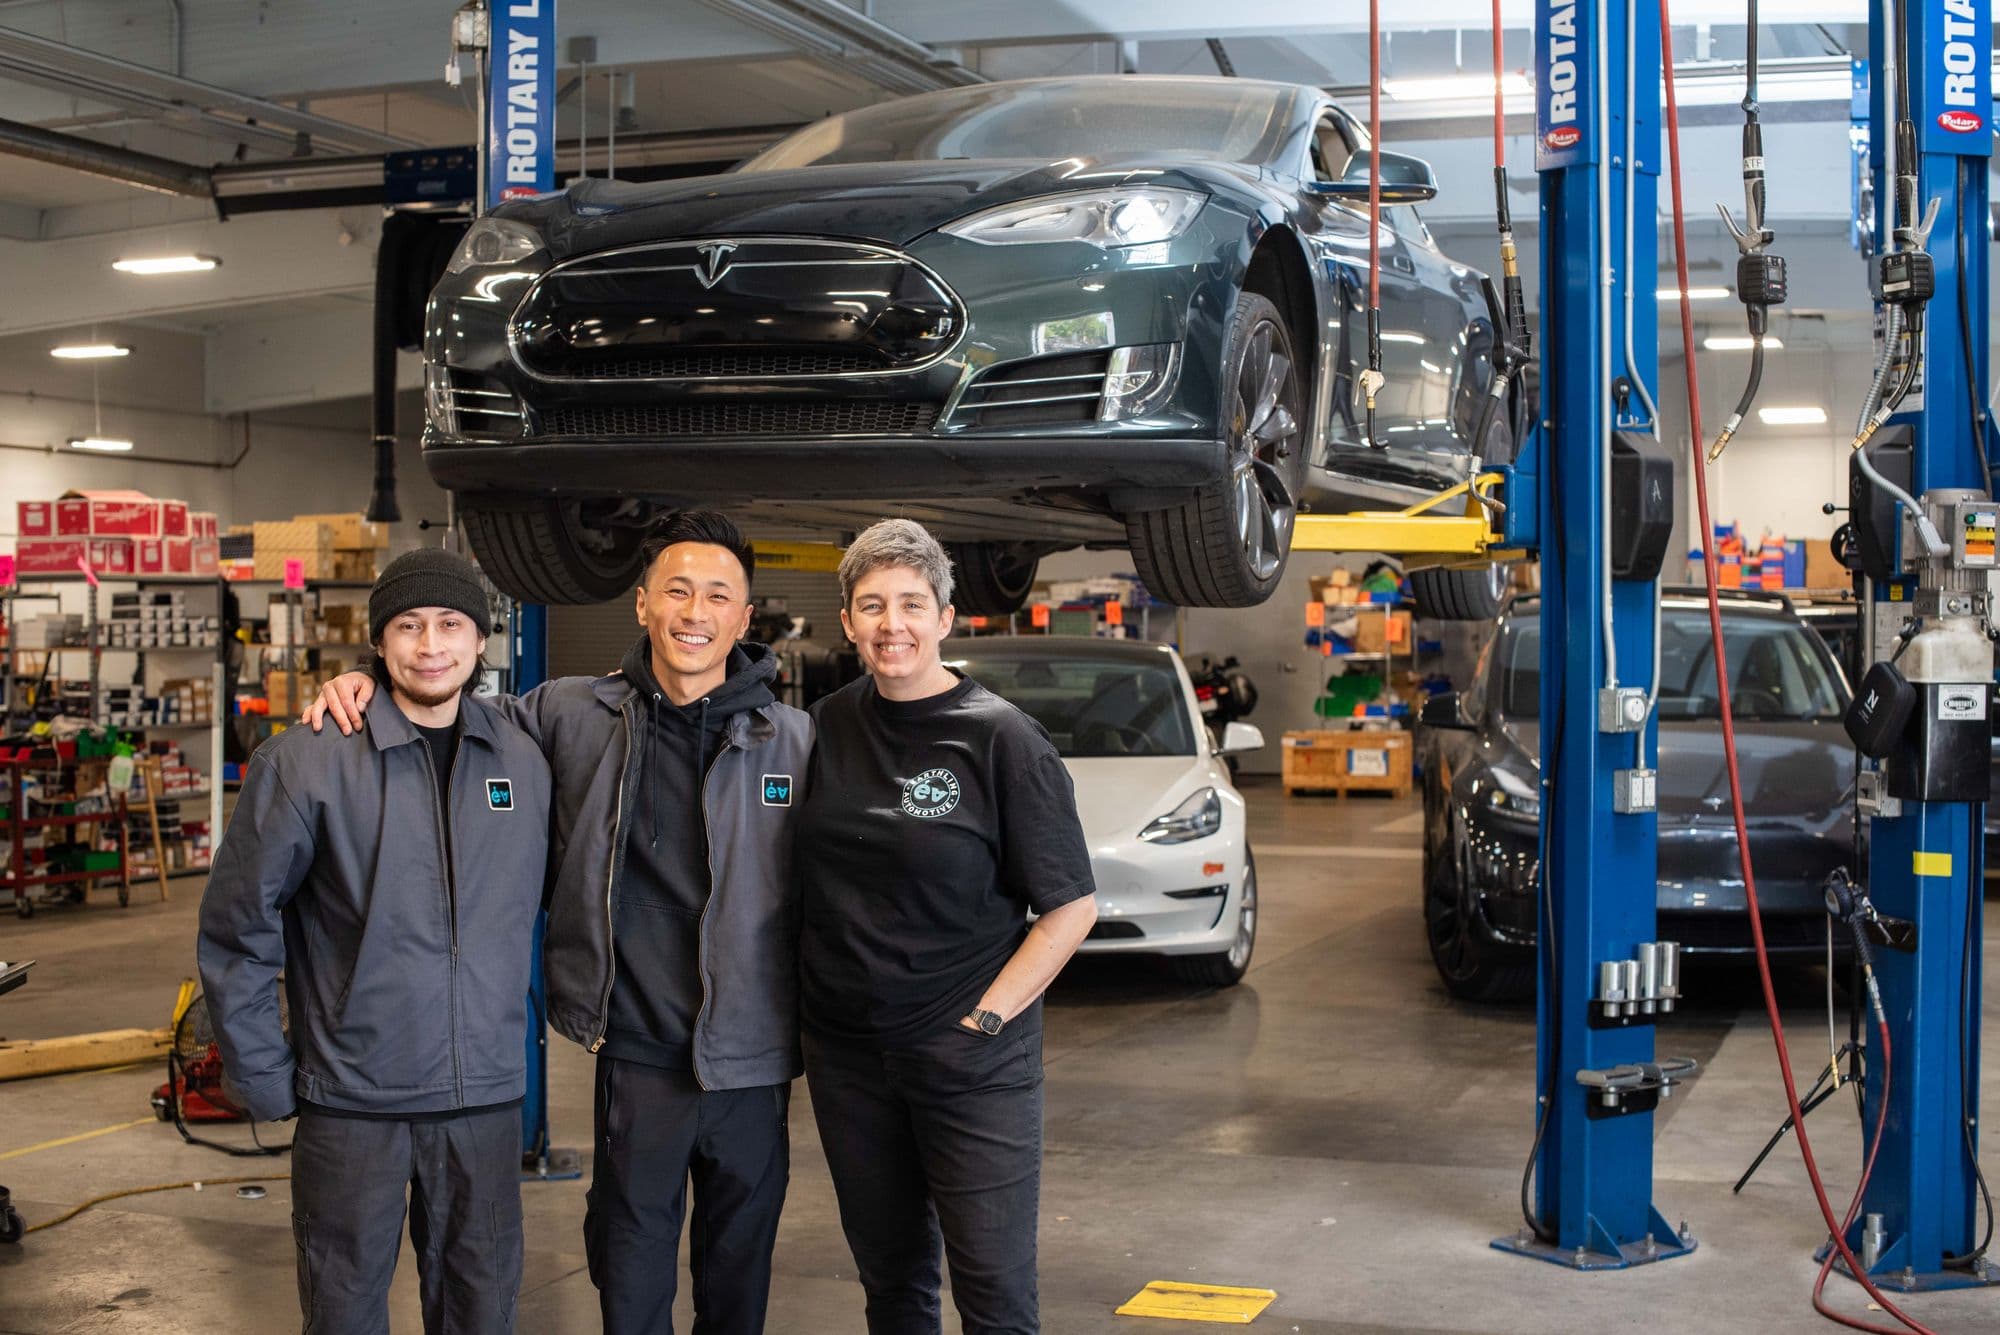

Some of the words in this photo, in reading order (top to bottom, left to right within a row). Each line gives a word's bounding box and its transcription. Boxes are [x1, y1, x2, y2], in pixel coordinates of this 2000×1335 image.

[507, 28, 539, 183] ROTARY
[1941, 112, 1978, 128] Rotary
[903, 791, 953, 816] AUTOMOTIVE
